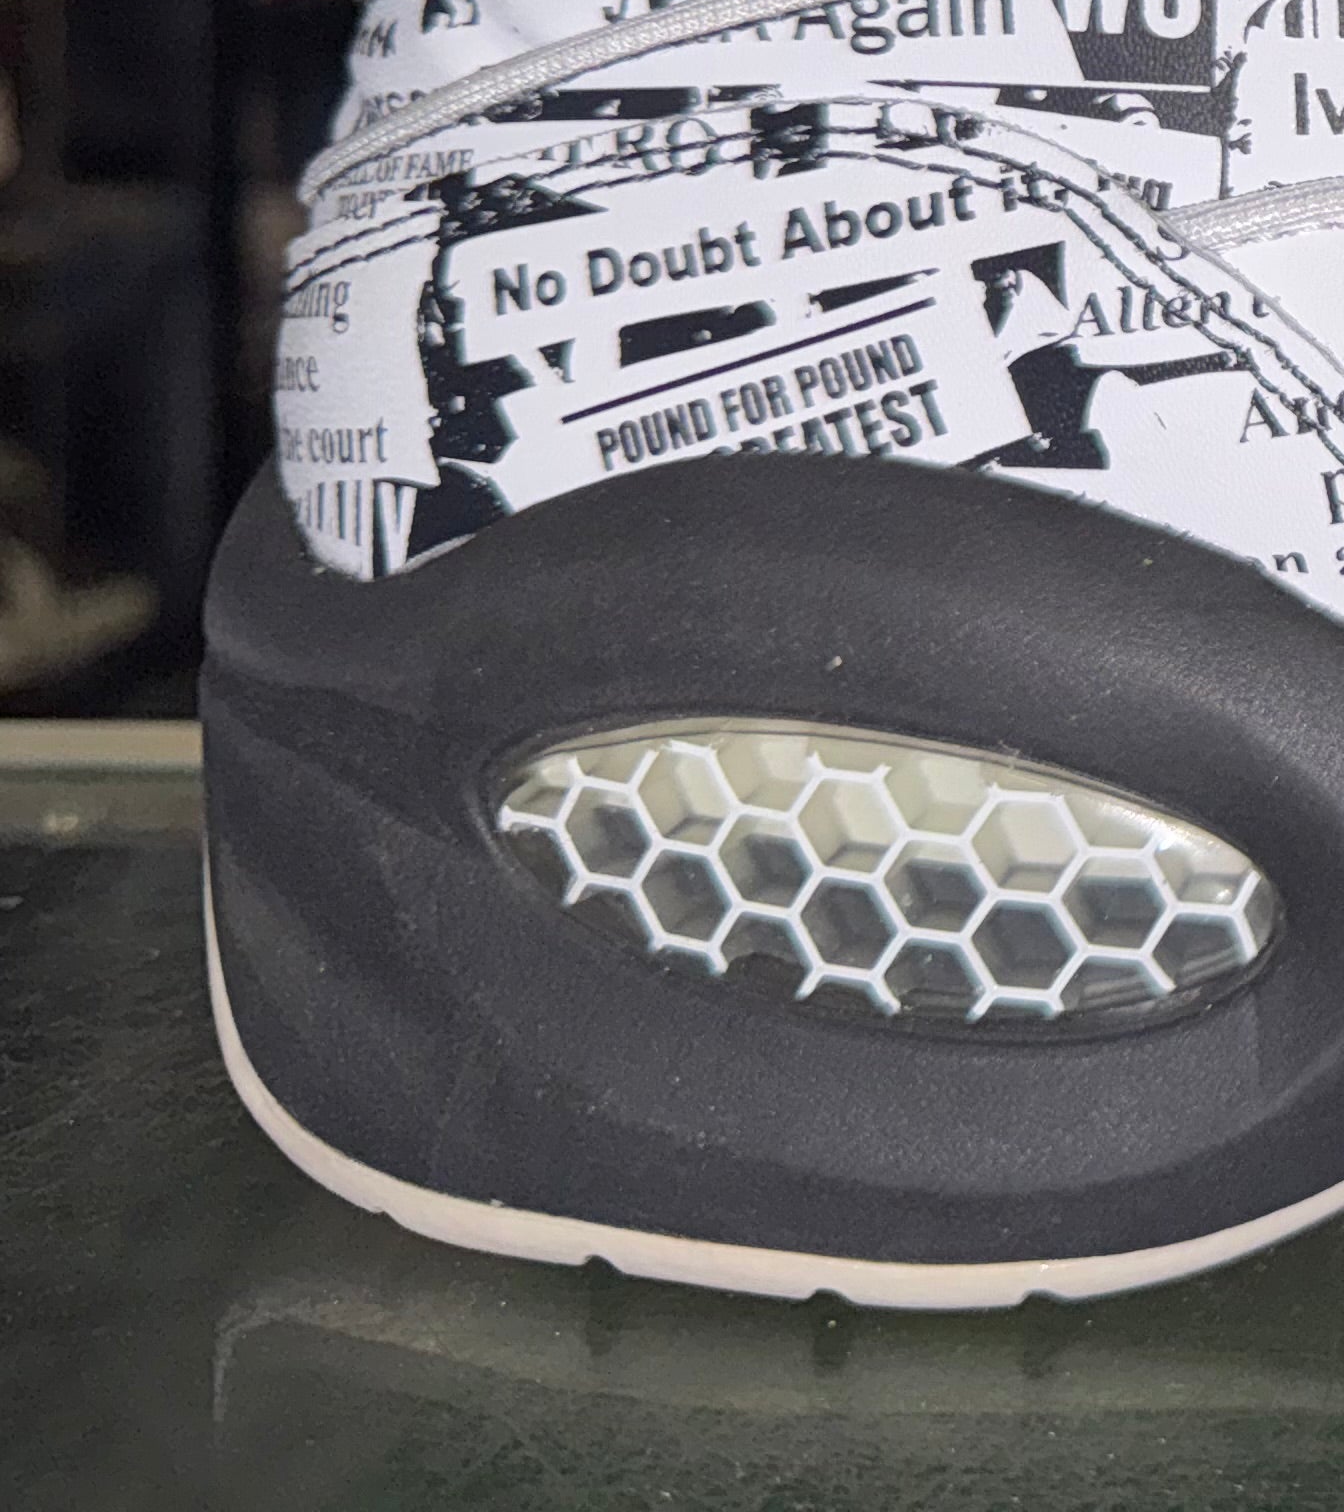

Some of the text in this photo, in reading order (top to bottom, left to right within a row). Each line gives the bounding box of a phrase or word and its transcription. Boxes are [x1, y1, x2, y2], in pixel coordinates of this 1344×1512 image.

[492, 262, 568, 316] No
[586, 221, 762, 299] Doubt
[781, 174, 979, 261] About
[308, 416, 388, 464] court
[595, 332, 926, 473] POUND FOR POUND
